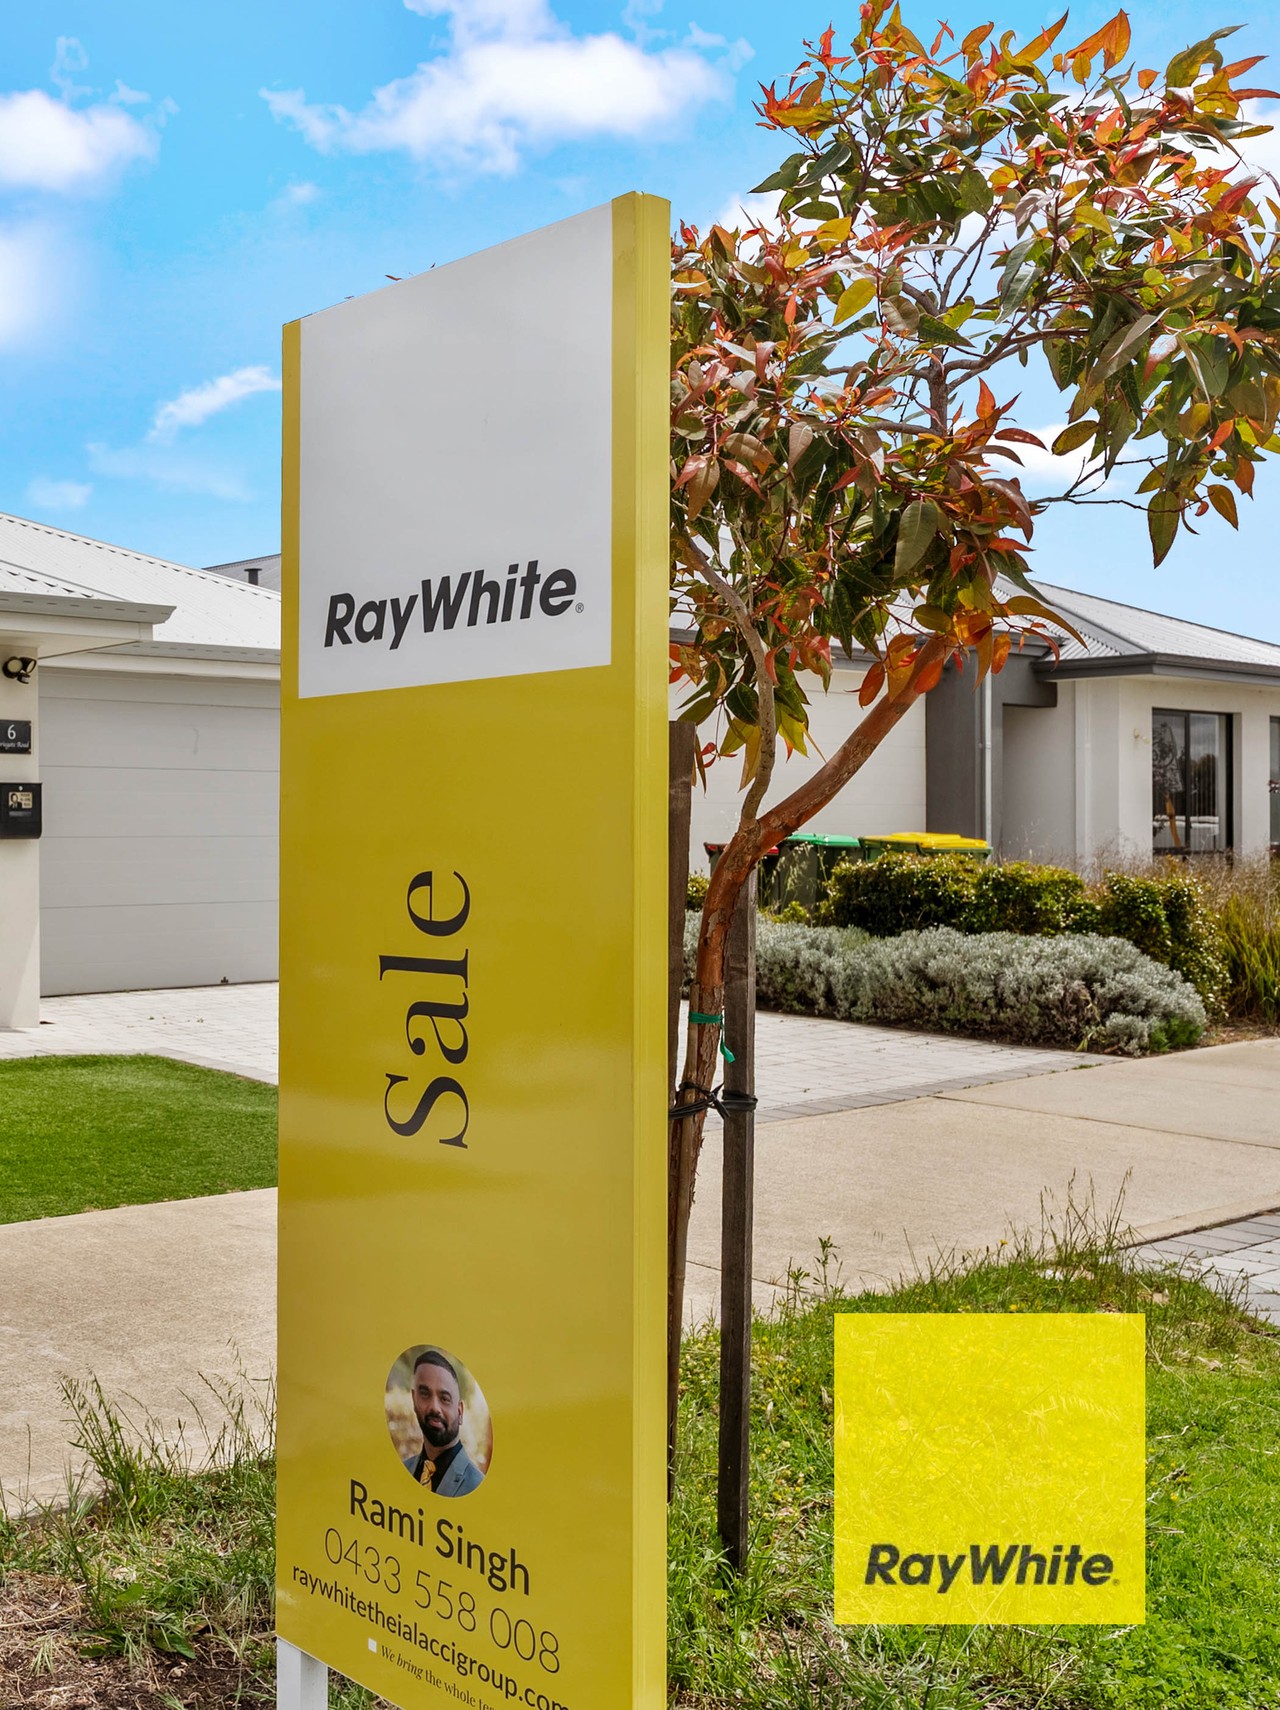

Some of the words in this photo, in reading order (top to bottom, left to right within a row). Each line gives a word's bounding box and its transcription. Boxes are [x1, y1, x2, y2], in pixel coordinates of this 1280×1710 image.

[7, 724, 17, 740] 6
[378, 870, 471, 1149] Sale
[349, 1479, 425, 1547] Rami
[435, 1518, 531, 1596] Singh
[324, 1527, 401, 1594] 0433
[414, 1569, 477, 1632] 558
[489, 1606, 561, 1674] 008
[381, 1644, 396, 1663] We
[396, 1653, 424, 1680] bring
[425, 1669, 442, 1689] the
[444, 1682, 476, 1708] whole
